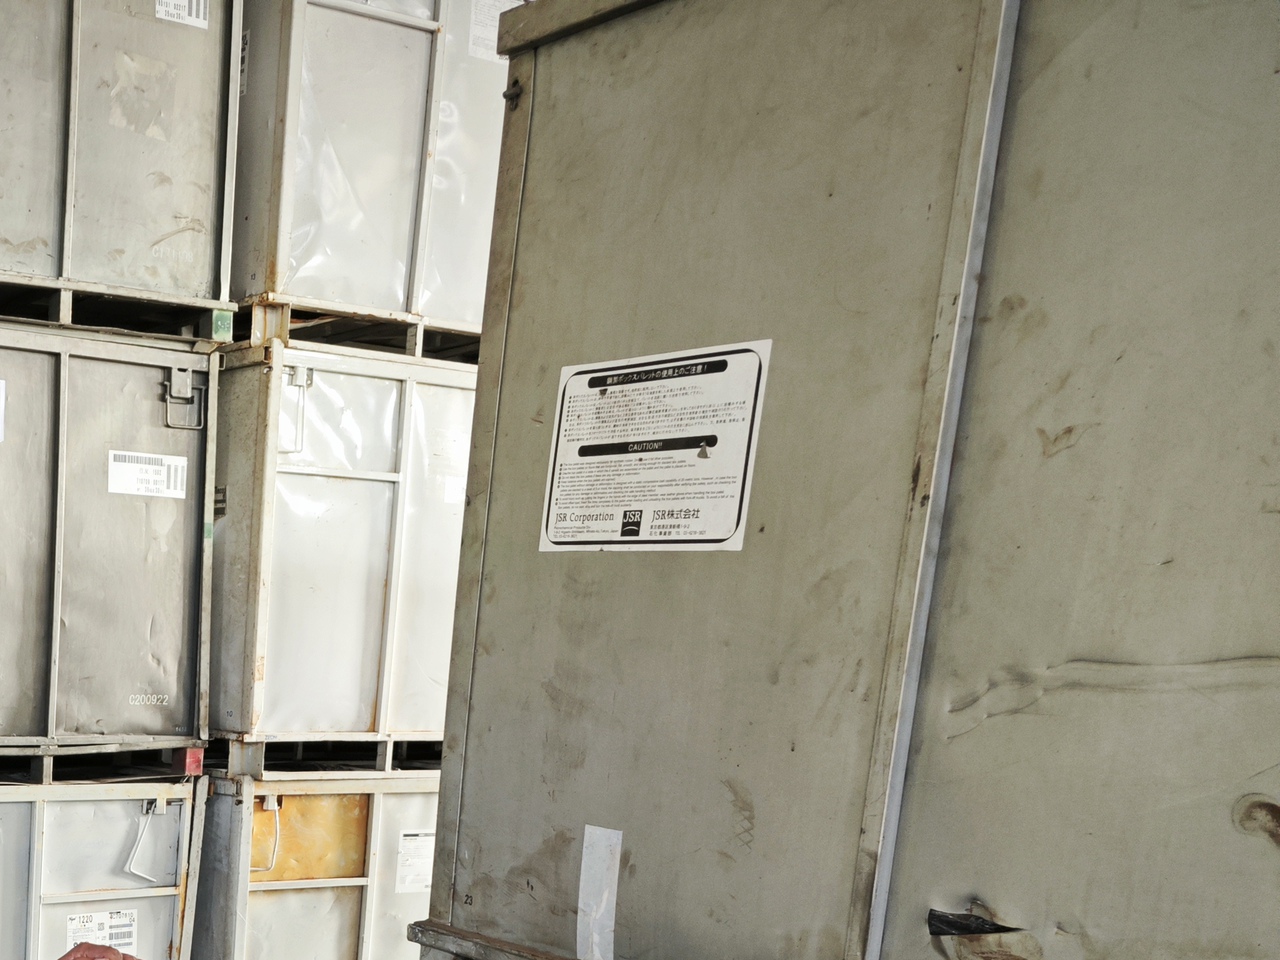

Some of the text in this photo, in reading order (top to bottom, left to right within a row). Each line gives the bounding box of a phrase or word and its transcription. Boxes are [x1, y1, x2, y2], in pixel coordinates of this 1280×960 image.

[627, 442, 663, 452] CAUTION!!
[555, 512, 614, 524] JSR Corporation
[623, 511, 641, 523] JSR
[651, 508, 701, 523] JSR株式会社
[129, 694, 169, 706] C200922
[463, 894, 473, 906] 23
[78, 915, 93, 924] 1220
